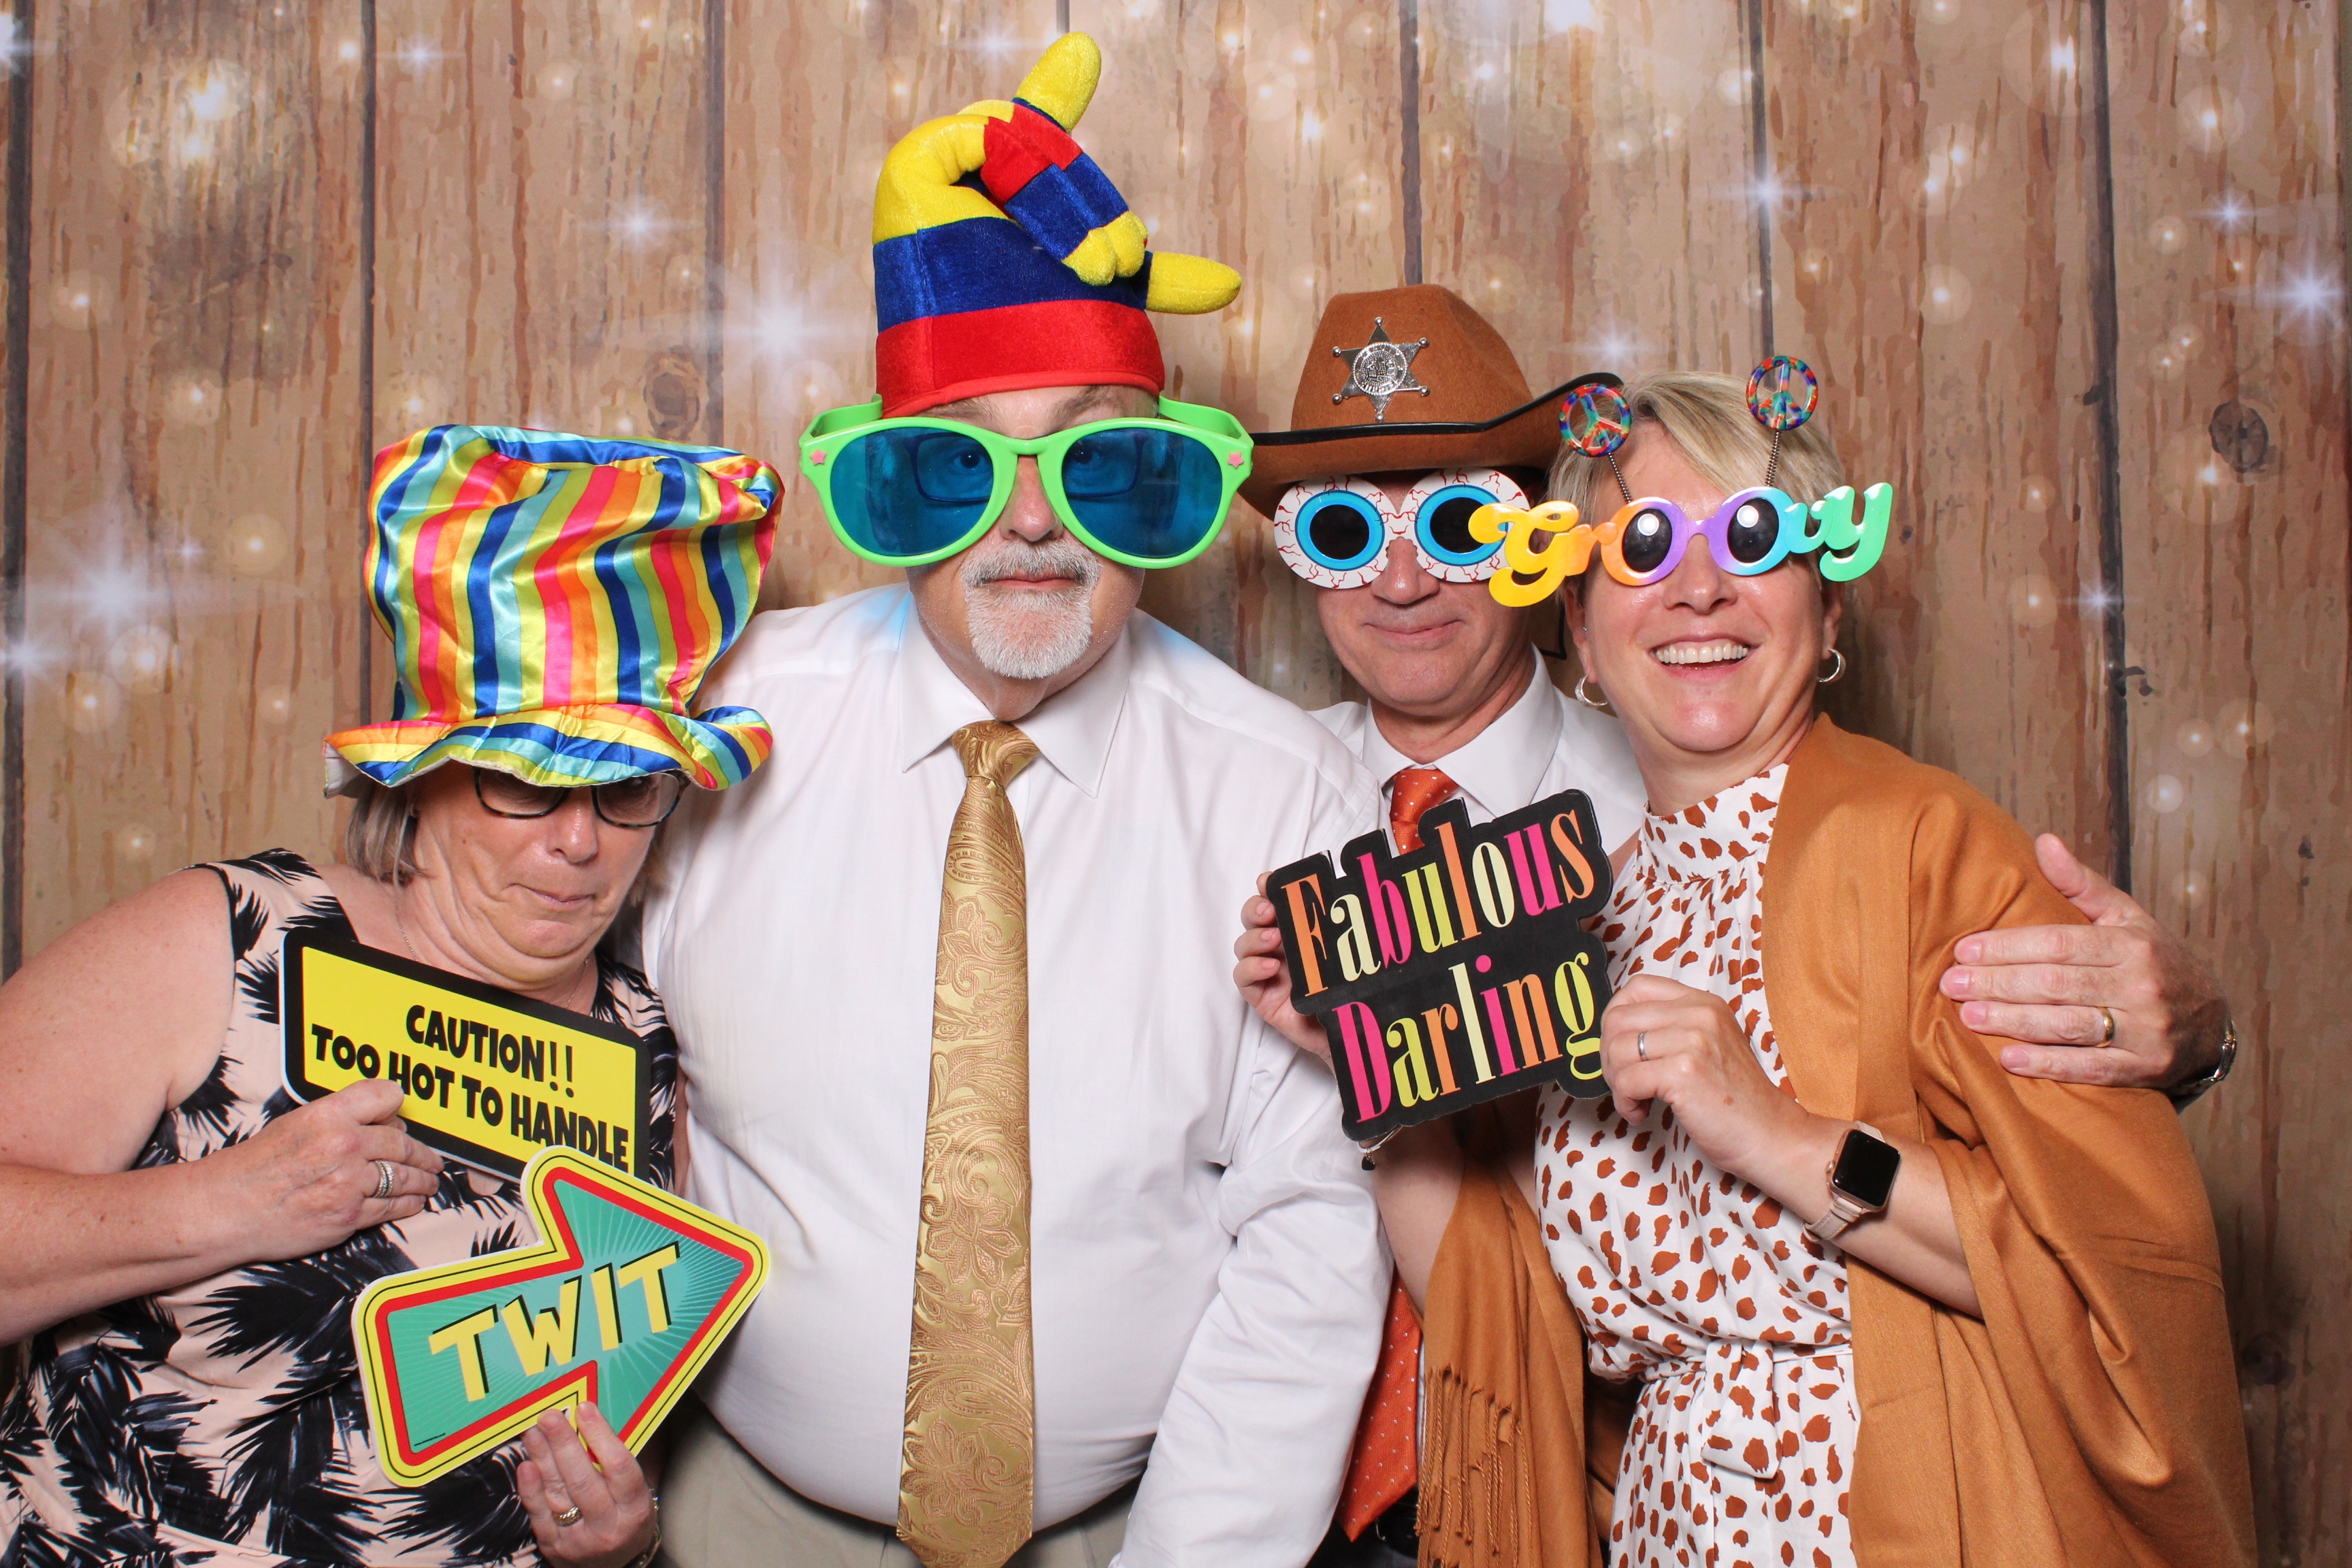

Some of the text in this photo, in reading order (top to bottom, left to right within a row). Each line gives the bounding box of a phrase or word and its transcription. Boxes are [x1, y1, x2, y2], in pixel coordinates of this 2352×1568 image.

[1280, 808, 1595, 998] Fabulous
[311, 1023, 629, 1174] TOO HOT TO HANDLE
[406, 1004, 574, 1098] CAUTION!!
[1331, 951, 1603, 1124] Darling
[427, 1240, 681, 1403] TWIT
